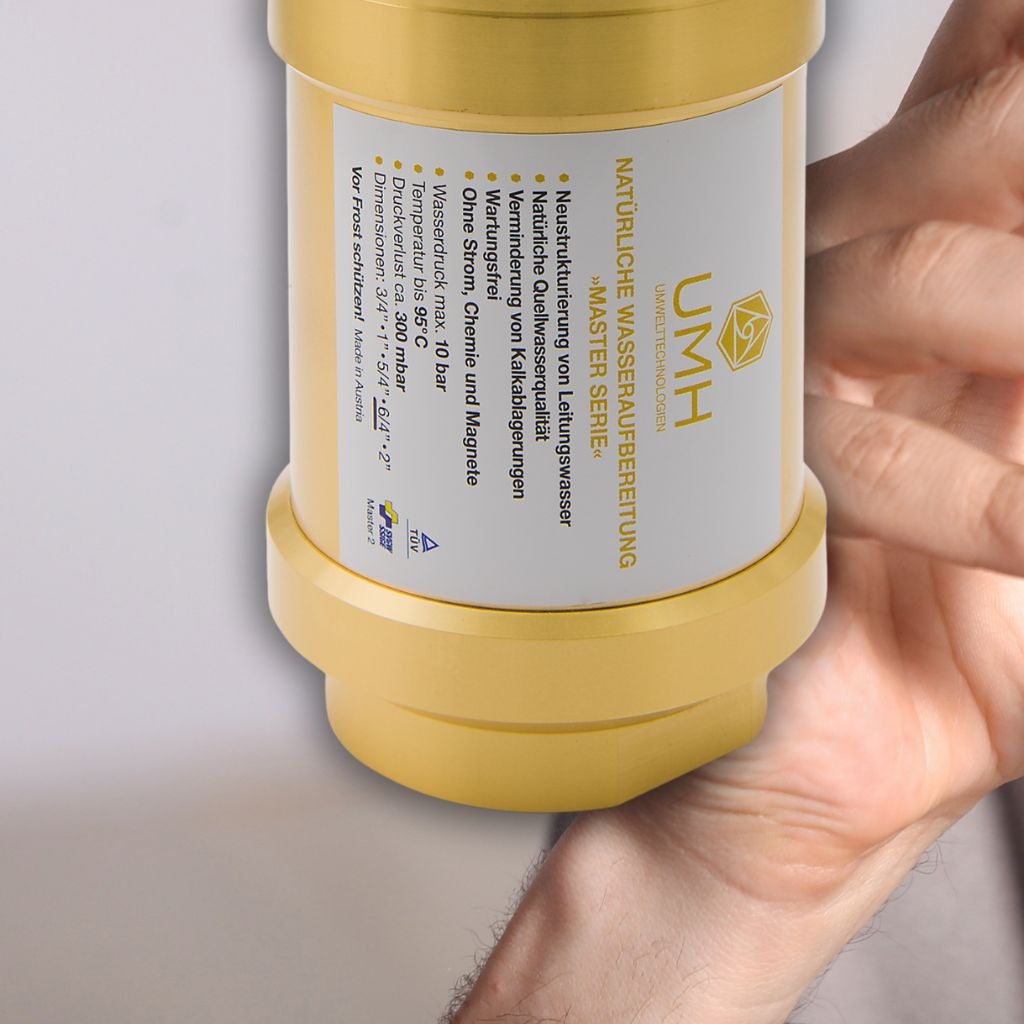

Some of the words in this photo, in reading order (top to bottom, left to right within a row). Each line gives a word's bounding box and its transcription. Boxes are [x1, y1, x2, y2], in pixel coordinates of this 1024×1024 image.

[352, 166, 363, 193] Vor
[352, 196, 363, 238] Frost
[374, 172, 388, 282] Dimensionen:
[393, 177, 407, 278] Druckverlust
[410, 181, 427, 273] Temperatur
[463, 187, 477, 233] Ohne
[533, 191, 548, 275] Natürliche
[616, 157, 638, 299] NATÜRLICHE
[433, 184, 448, 289] Wasserdruck
[483, 189, 502, 300] Wartungsfrei
[507, 190, 524, 307] Verminderung
[353, 243, 364, 322] schützen!
[413, 278, 427, 301] bis
[461, 239, 478, 296] Strom,
[555, 190, 572, 348] Neustrukturierung
[394, 283, 405, 306] ca.
[434, 295, 446, 333] max.
[354, 329, 364, 363] Made
[395, 311, 408, 342] 300
[414, 306, 428, 349] 95°C
[435, 340, 449, 358] 10
[464, 302, 479, 367] Chemie
[510, 313, 522, 342] von
[673, 272, 712, 428] UMH
[354, 366, 364, 377] in
[395, 346, 408, 392] mbar
[435, 363, 449, 392] bar
[532, 280, 550, 441] Quellwasserqualität
[558, 354, 570, 385] von
[655, 284, 666, 432] UMWELTTECHNOLOGIEN
[354, 380, 365, 422] Austria
[465, 373, 480, 406] und
[463, 411, 481, 486] Magnete
[509, 348, 527, 499] Kalkablagerungen
[617, 305, 636, 569] WASSERAUFBEREITUNG
[556, 391, 573, 527] Leitungswasser
[368, 537, 375, 545] 2
[410, 529, 420, 553] TÜV
